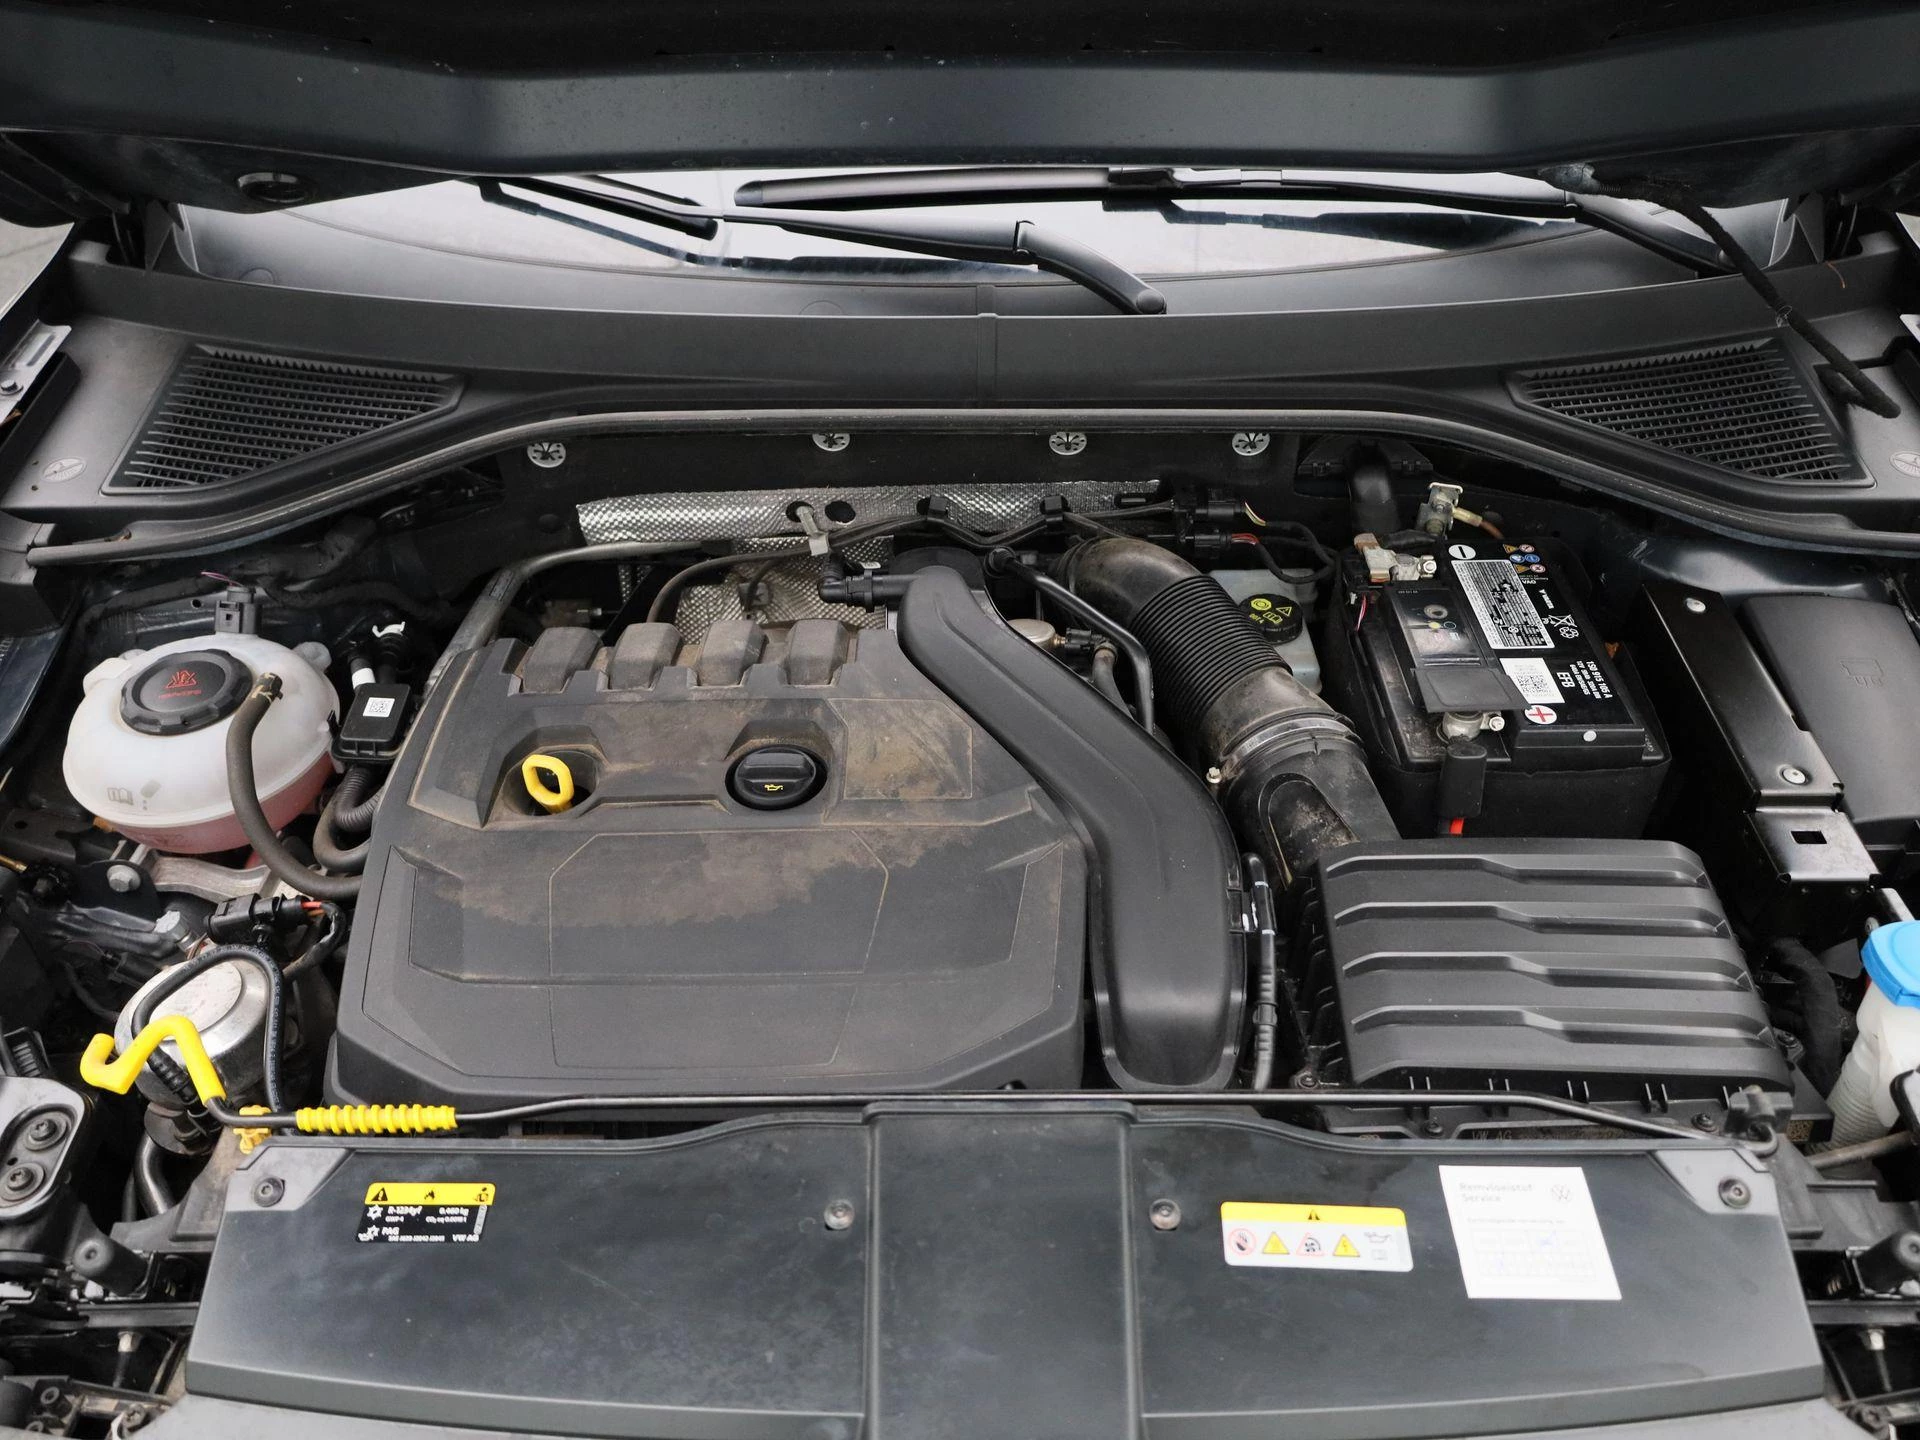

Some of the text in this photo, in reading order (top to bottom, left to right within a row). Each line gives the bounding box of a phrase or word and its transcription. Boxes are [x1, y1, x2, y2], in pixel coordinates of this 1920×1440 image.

[1556, 672, 1576, 688] EFB
[1592, 671, 1604, 682] 915
[1598, 682, 1610, 693] 105
[1461, 1193, 1501, 1202] Service
[382, 1226, 400, 1235] PAG
[452, 1234, 466, 1242] VW
[466, 1234, 480, 1242] AG
